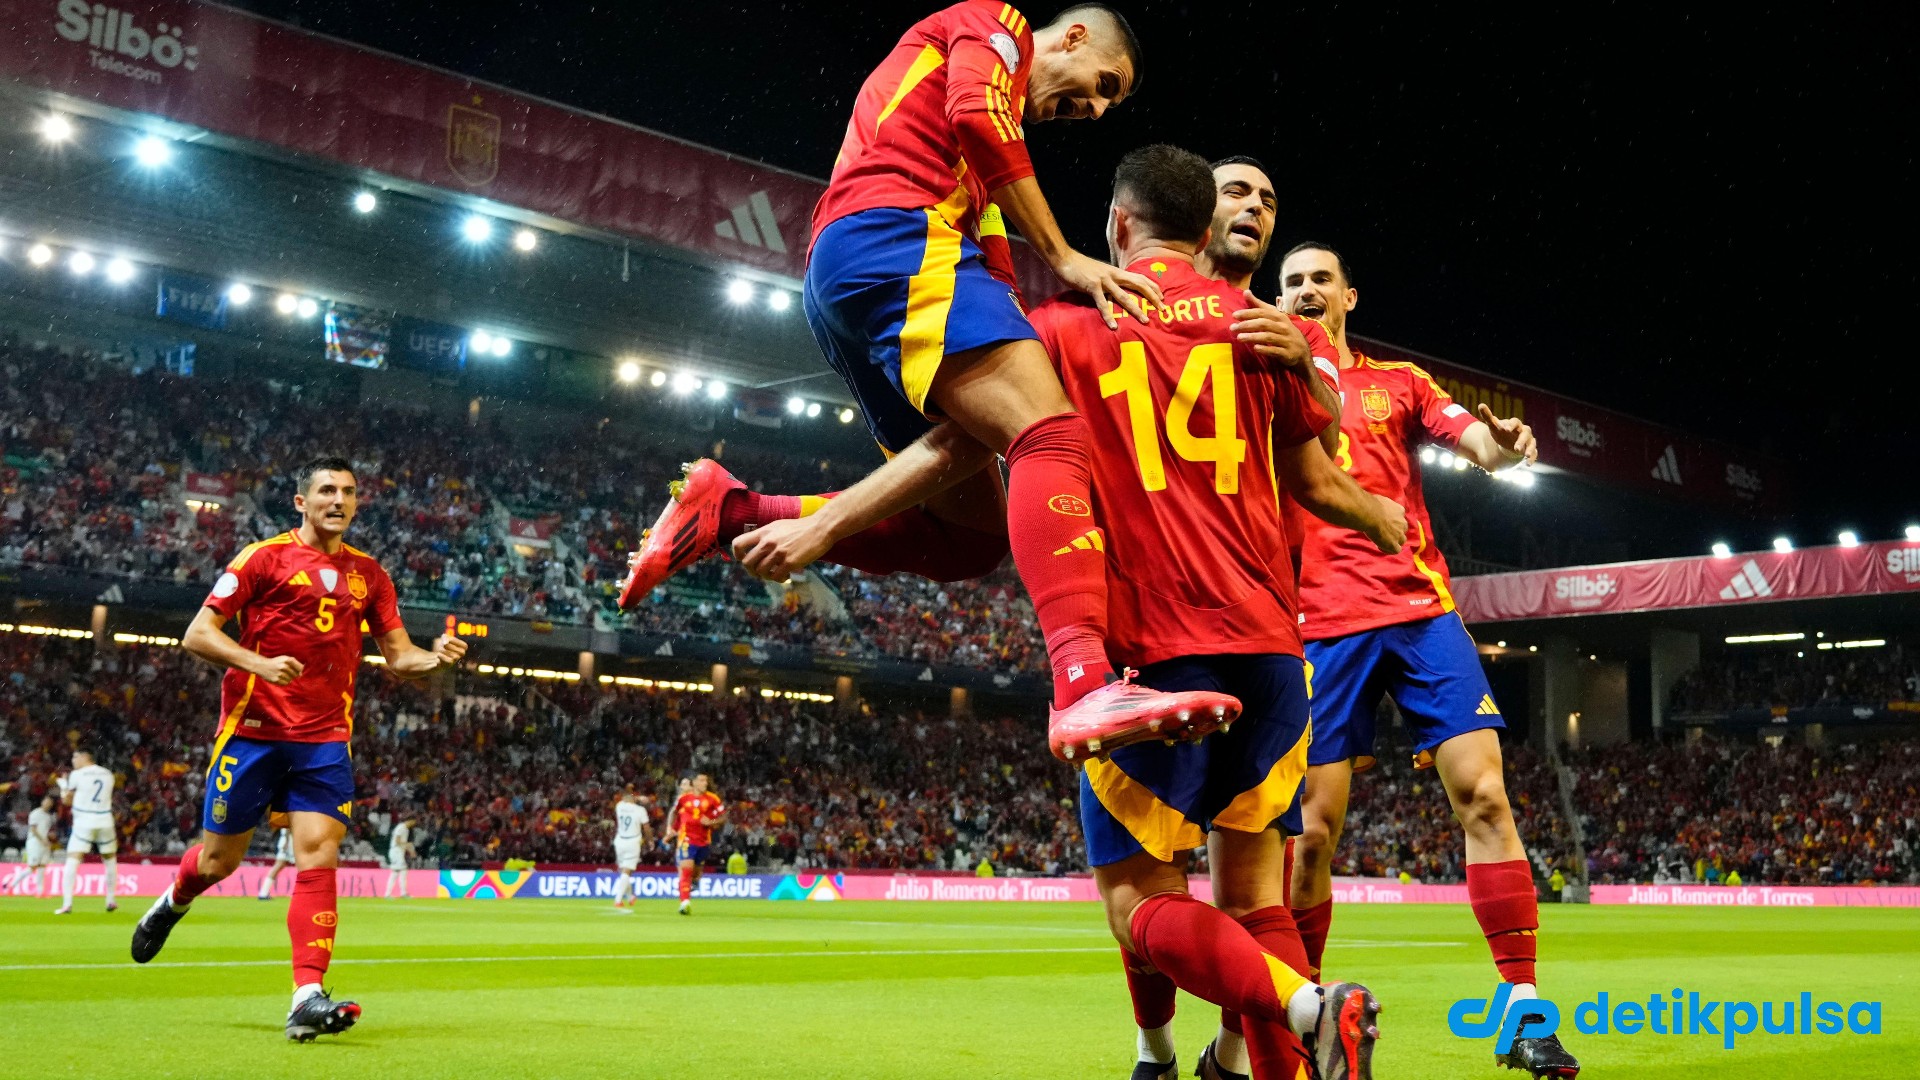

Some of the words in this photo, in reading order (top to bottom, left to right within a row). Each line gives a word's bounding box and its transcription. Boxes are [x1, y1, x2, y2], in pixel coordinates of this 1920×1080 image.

[89, 50, 162, 84] Telecom
[1098, 340, 1246, 494] 14
[315, 597, 336, 632] 5
[216, 755, 238, 792] 5
[92, 779, 104, 803] 2
[619, 816, 632, 831] 19
[538, 876, 587, 897] UEFA
[885, 879, 929, 899] Julio
[932, 879, 995, 900] Romero
[998, 881, 1018, 900] de
[1020, 880, 1070, 900] Torres
[1628, 887, 1668, 905] Julio
[1671, 888, 1733, 905] Romero
[1737, 888, 1757, 905] de
[1760, 889, 1814, 906] Torres
